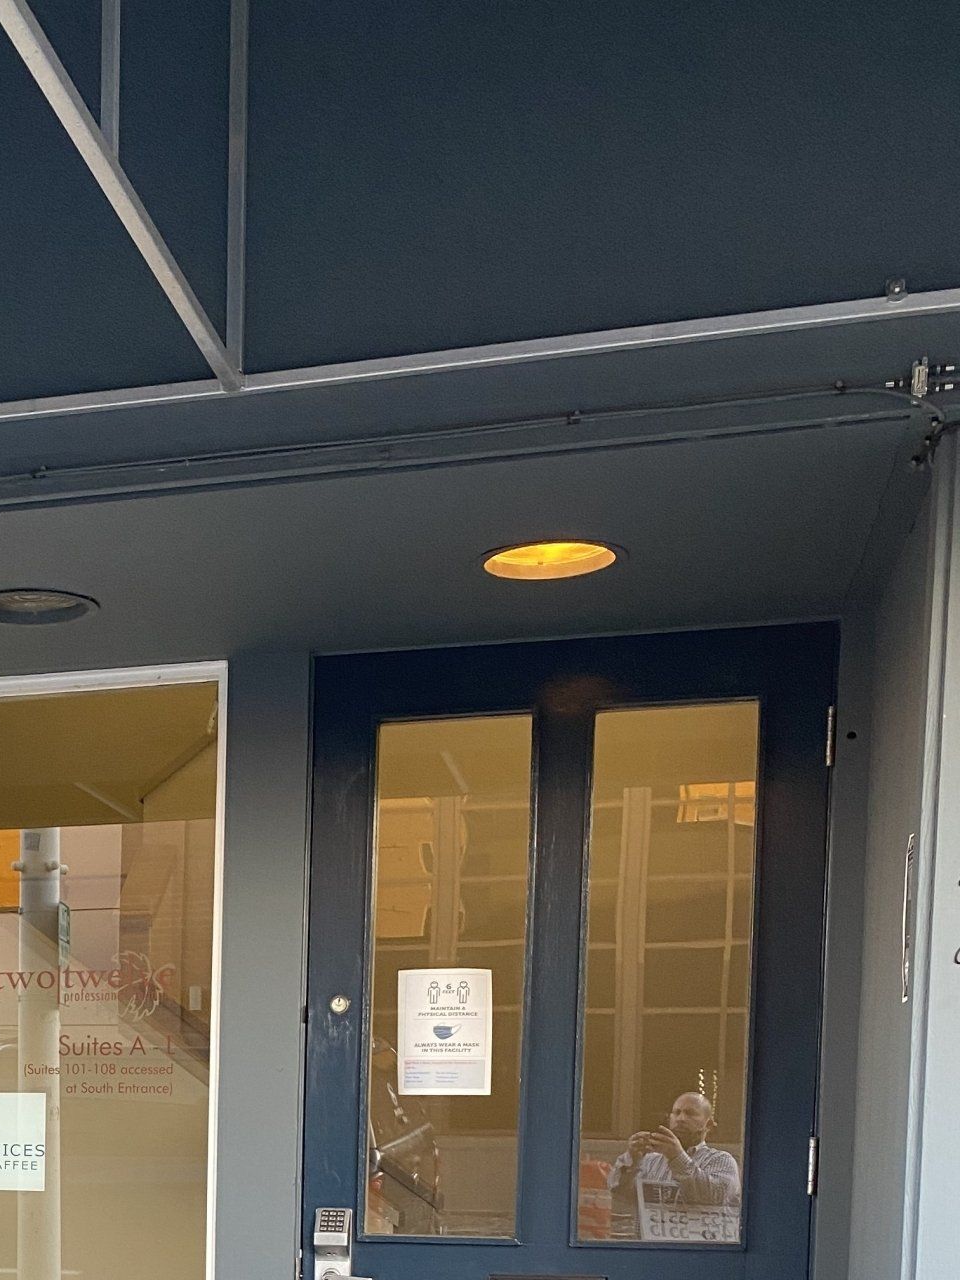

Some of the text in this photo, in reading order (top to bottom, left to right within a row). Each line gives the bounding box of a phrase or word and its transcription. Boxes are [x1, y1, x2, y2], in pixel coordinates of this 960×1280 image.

[59, 1035, 123, 1056] Suites
[129, 1036, 146, 1056] A
[24, 1063, 174, 1078] (Suites 101-108 accessed
[65, 1082, 173, 1096] at South Entrance)
